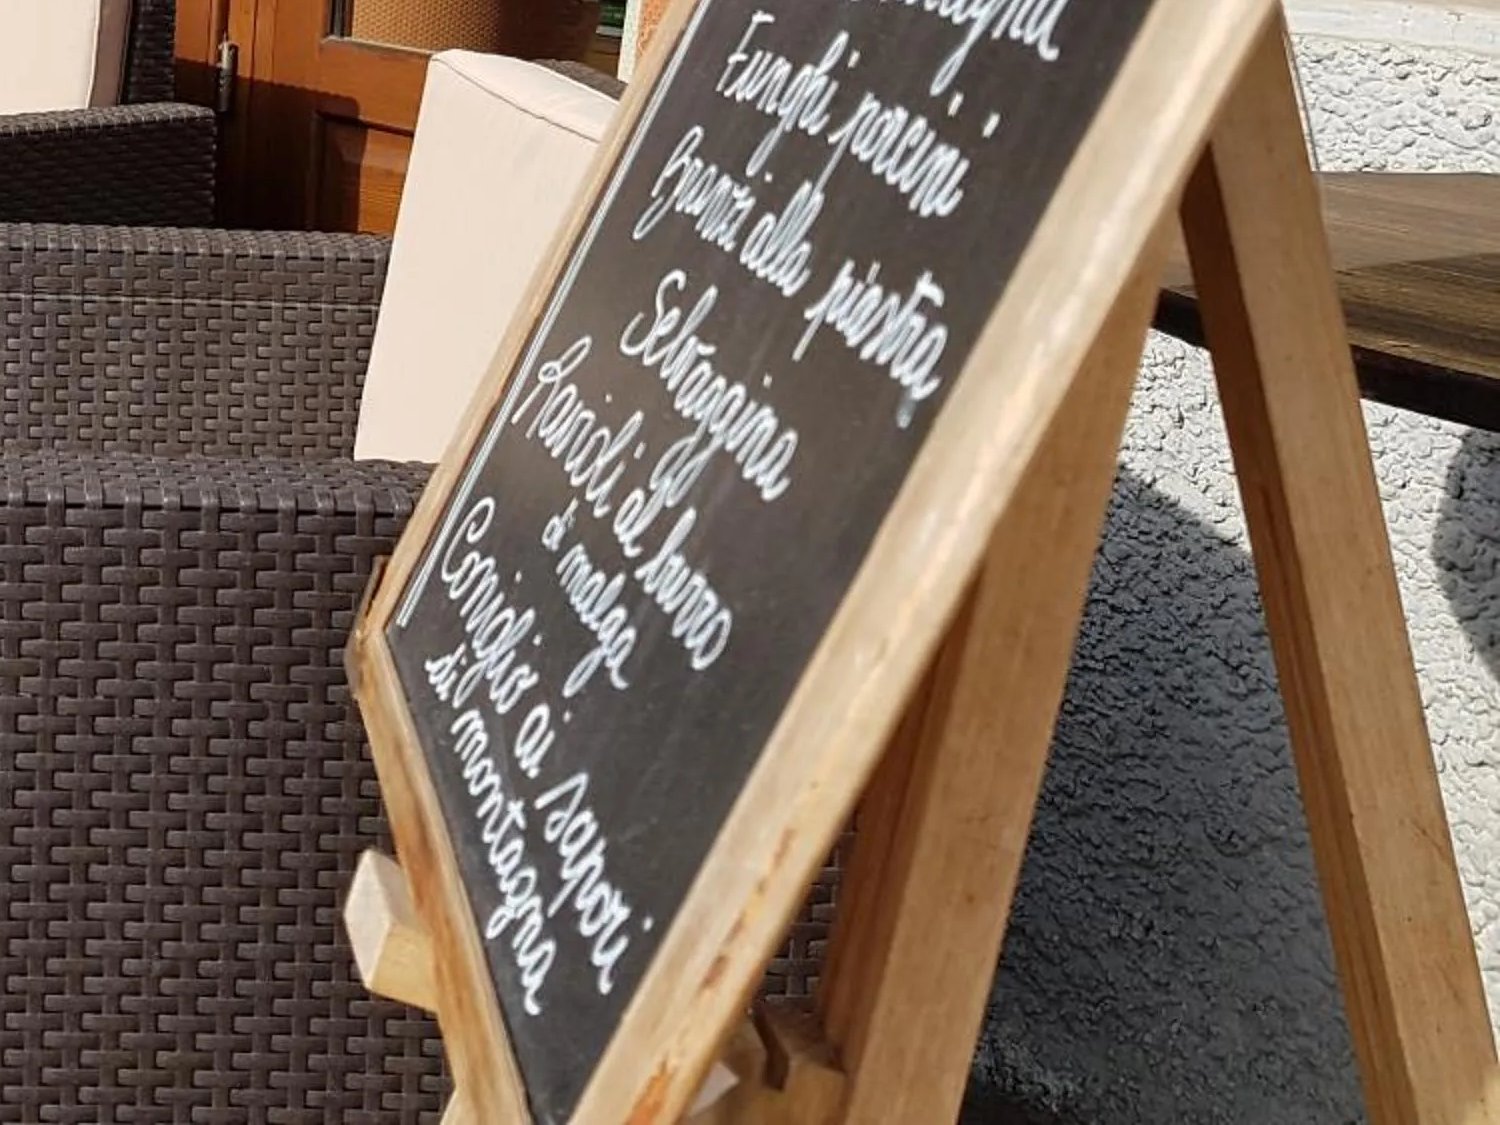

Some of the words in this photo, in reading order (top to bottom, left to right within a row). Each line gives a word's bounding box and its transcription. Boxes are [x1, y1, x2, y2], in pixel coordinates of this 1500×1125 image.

[716, 10, 861, 177] Funghi
[814, 92, 1000, 217] porcini
[633, 126, 772, 252] Branzi
[740, 181, 824, 297] alla
[792, 259, 948, 402] piastra
[510, 335, 647, 518] Ravioli
[619, 269, 799, 507] Selvaggina
[441, 495, 542, 714] Coniglio
[541, 499, 579, 550] di
[612, 475, 672, 559] al
[635, 507, 733, 670] burro
[556, 543, 637, 697] malga
[424, 643, 466, 701] di
[450, 710, 556, 1015] montagna
[513, 703, 572, 779] ai
[534, 773, 654, 995] sapori
